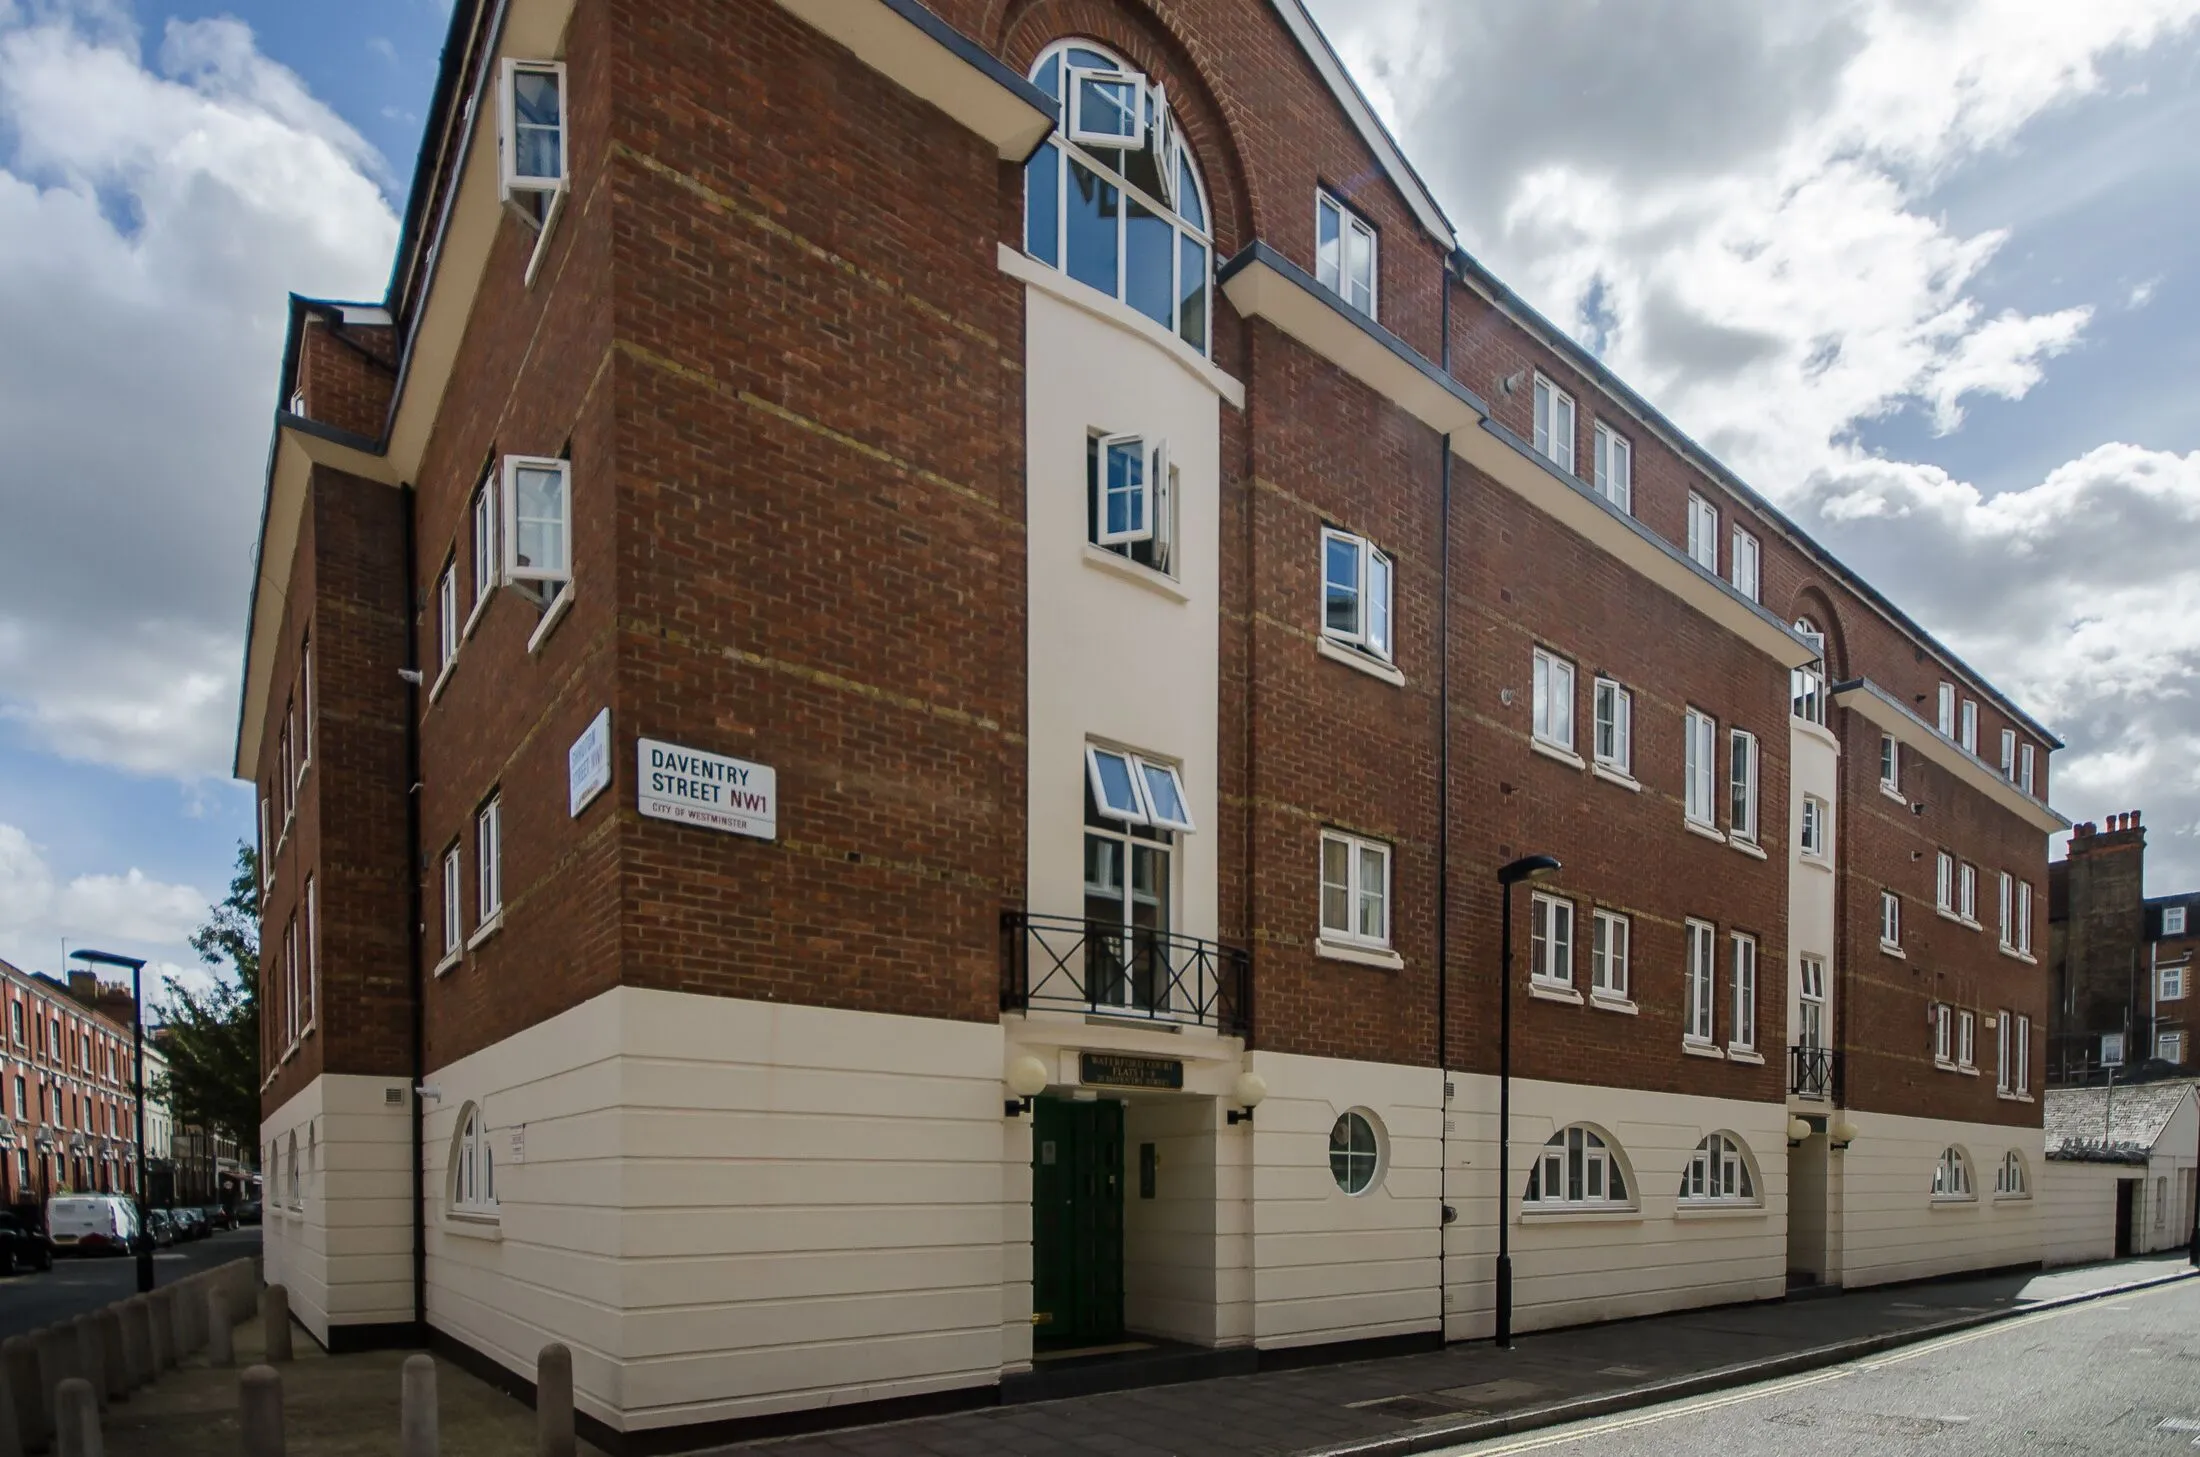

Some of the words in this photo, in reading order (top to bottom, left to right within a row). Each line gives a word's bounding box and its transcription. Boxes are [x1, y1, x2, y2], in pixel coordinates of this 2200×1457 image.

[652, 749, 749, 786] DAVENTRY
[652, 772, 720, 803] STREET
[731, 790, 766, 814] NW1
[652, 802, 671, 814] CITY
[675, 807, 685, 817] OF
[688, 810, 747, 829] WESTMINSTER
[1113, 1066, 1138, 1077] FLATS
[1146, 1061, 1175, 1072] COURT
